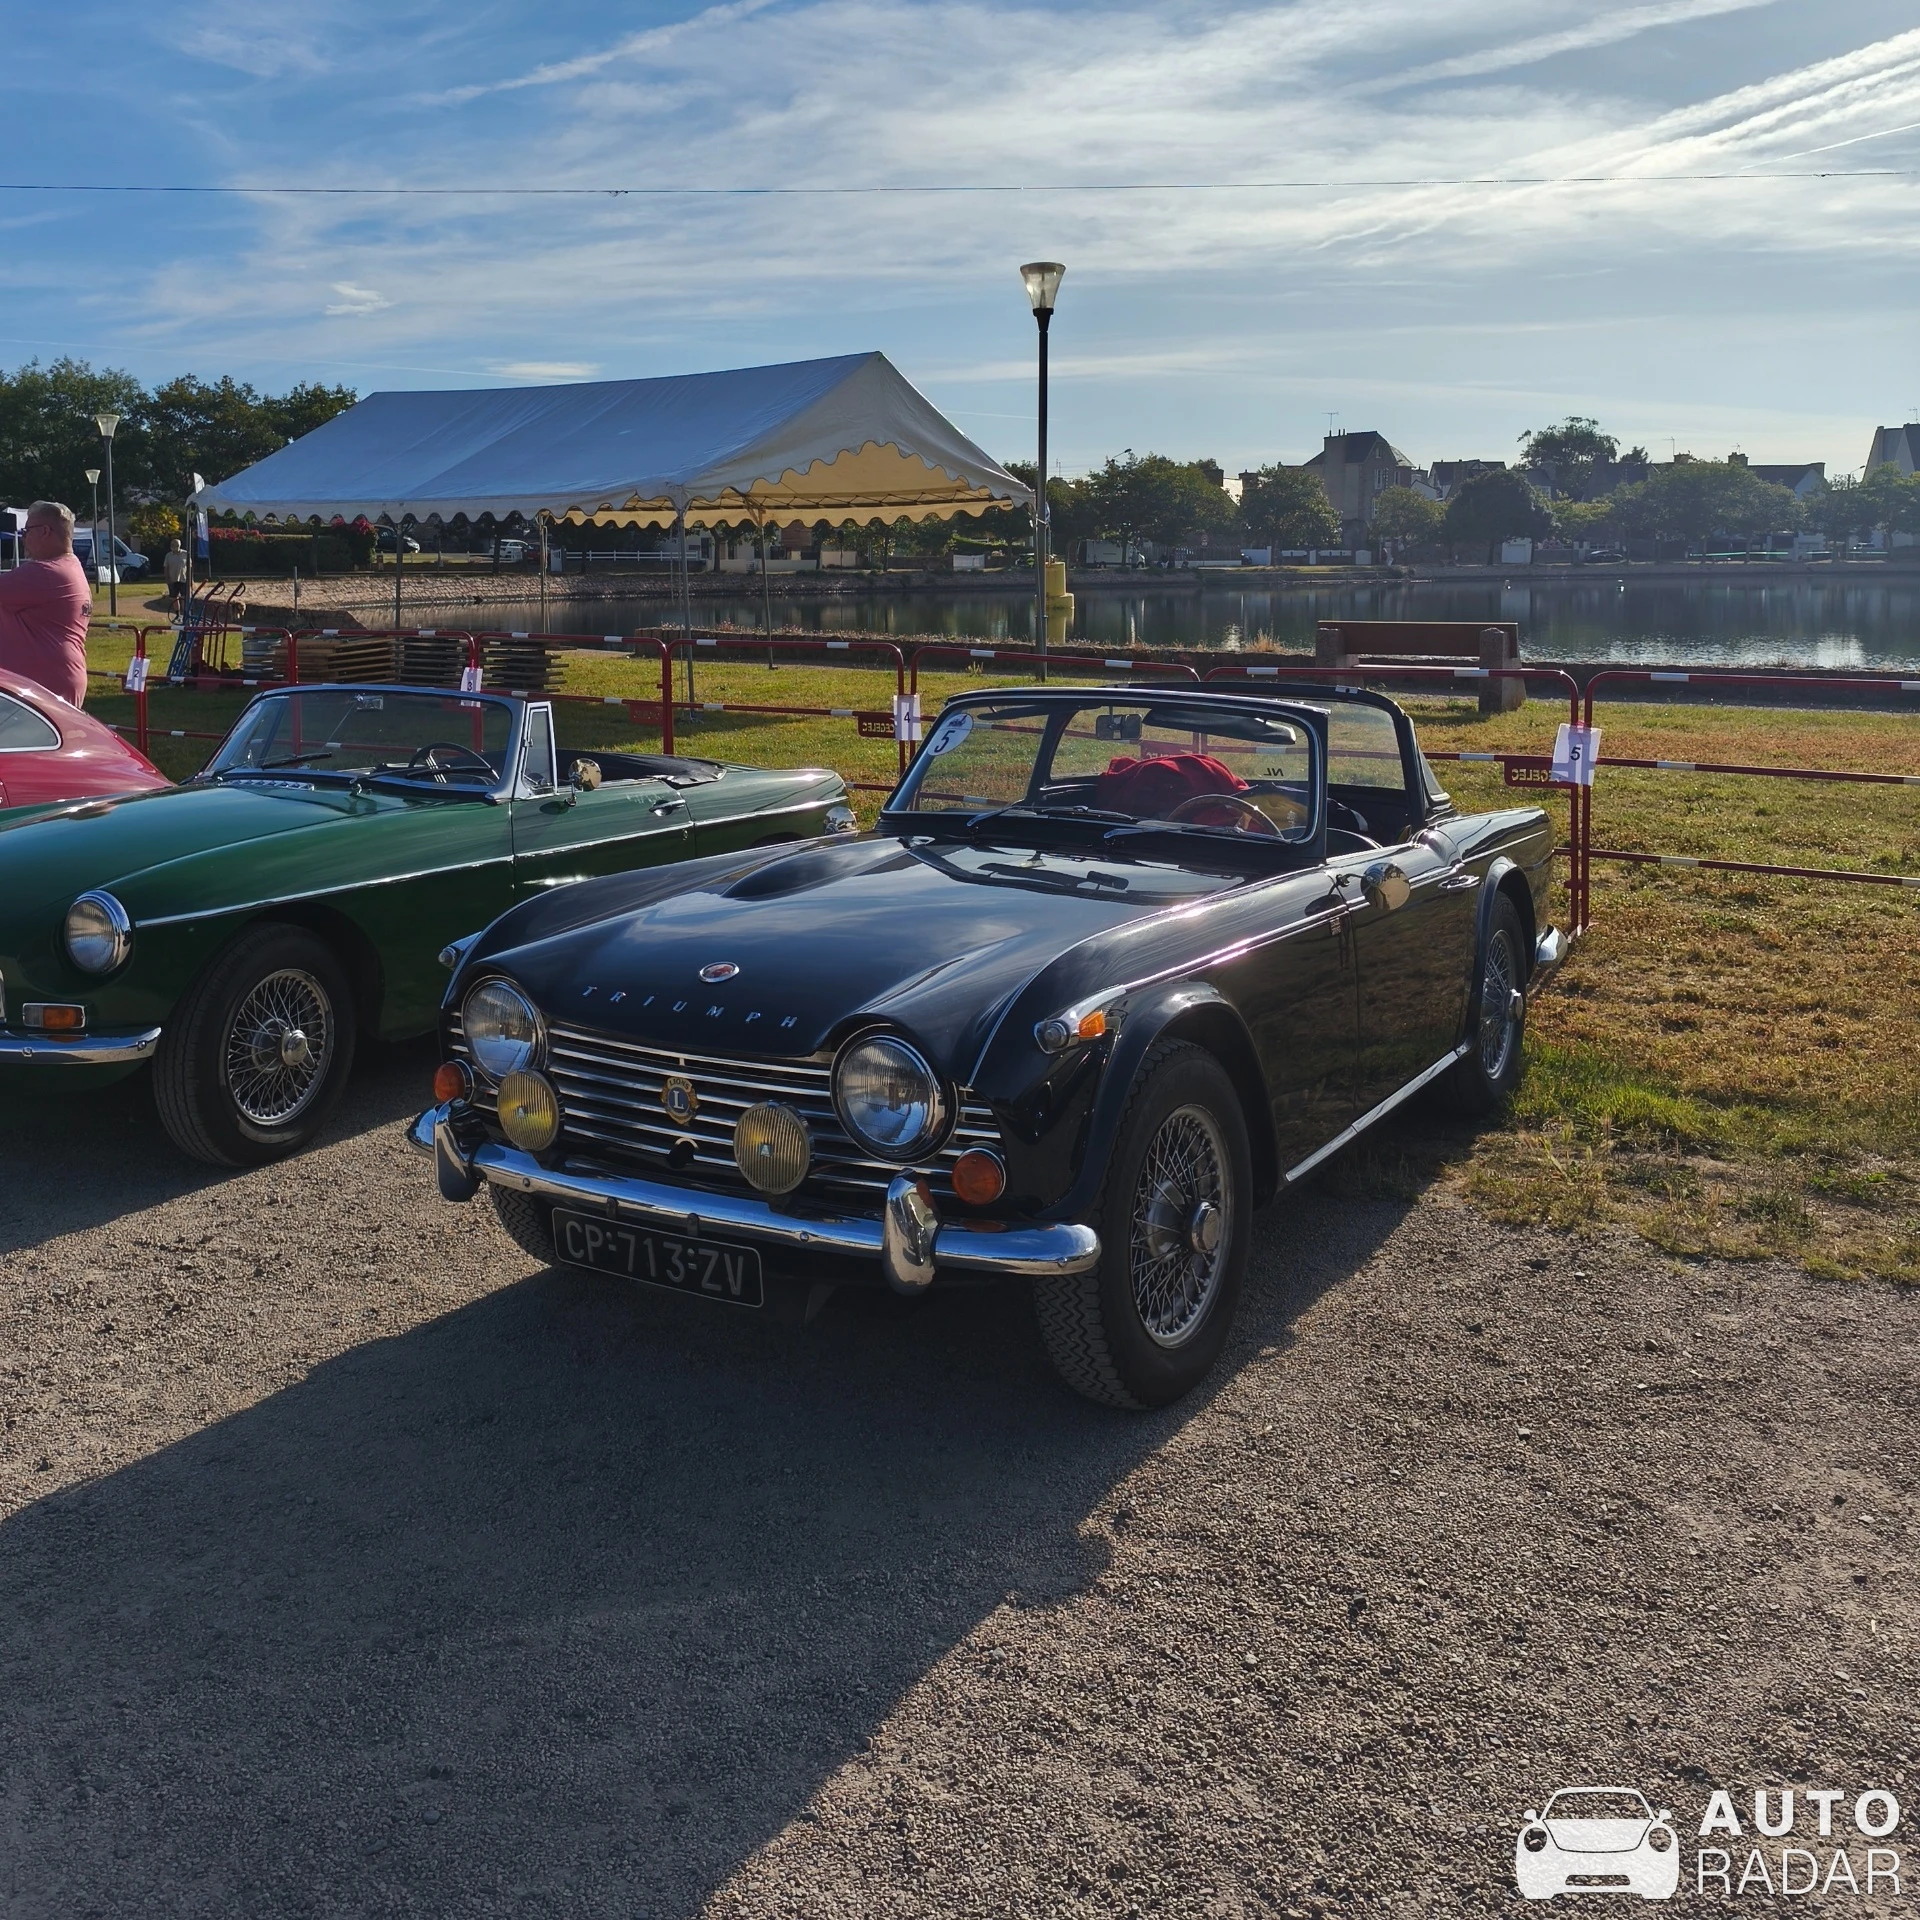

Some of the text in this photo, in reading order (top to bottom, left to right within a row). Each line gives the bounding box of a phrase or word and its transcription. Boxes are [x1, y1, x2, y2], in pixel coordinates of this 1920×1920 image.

[133, 669, 140, 678] 2
[467, 681, 473, 692] 3
[903, 711, 911, 723] 4
[934, 730, 956, 753] 5
[1570, 746, 1581, 761] 5
[582, 985, 798, 1028] TRIUMPH
[669, 1078, 691, 1090] LIONS
[673, 1090, 685, 1110] L
